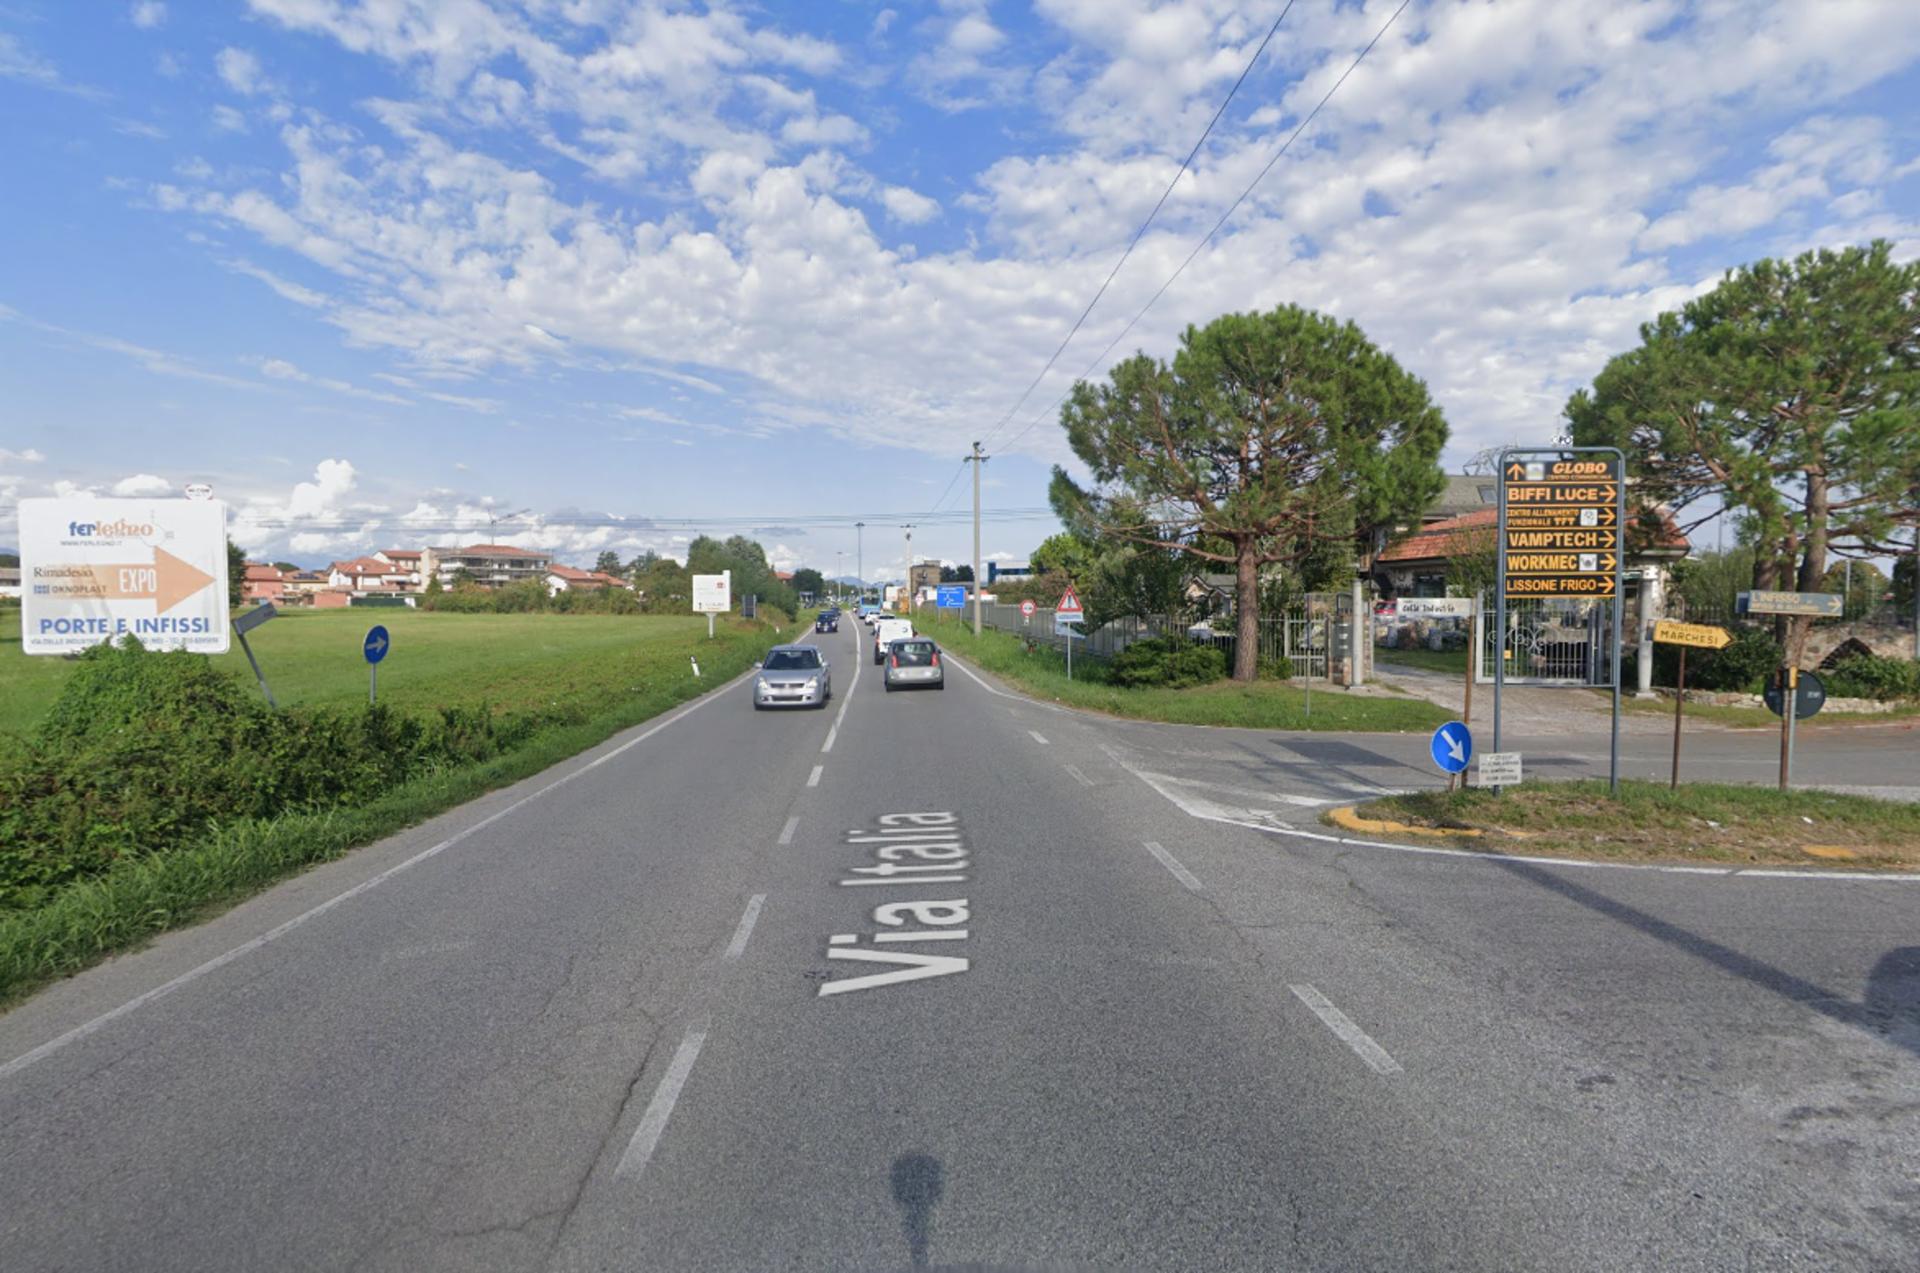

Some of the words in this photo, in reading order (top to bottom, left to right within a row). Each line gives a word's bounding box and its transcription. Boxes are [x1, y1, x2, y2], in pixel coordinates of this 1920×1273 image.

[1552, 462, 1607, 474] GLOBO
[1508, 488, 1551, 501] BIFFI
[1556, 488, 1598, 501] LUCE
[1509, 532, 1597, 547] VAMPTECH
[1508, 555, 1577, 570] WORKMEC
[119, 568, 157, 593] EXPO
[1507, 580, 1557, 591] LISSONE
[1560, 580, 1597, 591] FRIGO
[40, 618, 108, 634] PORTE
[117, 618, 127, 634] E
[136, 617, 209, 633] INFISSI
[1660, 630, 1718, 645] MARCHESI
